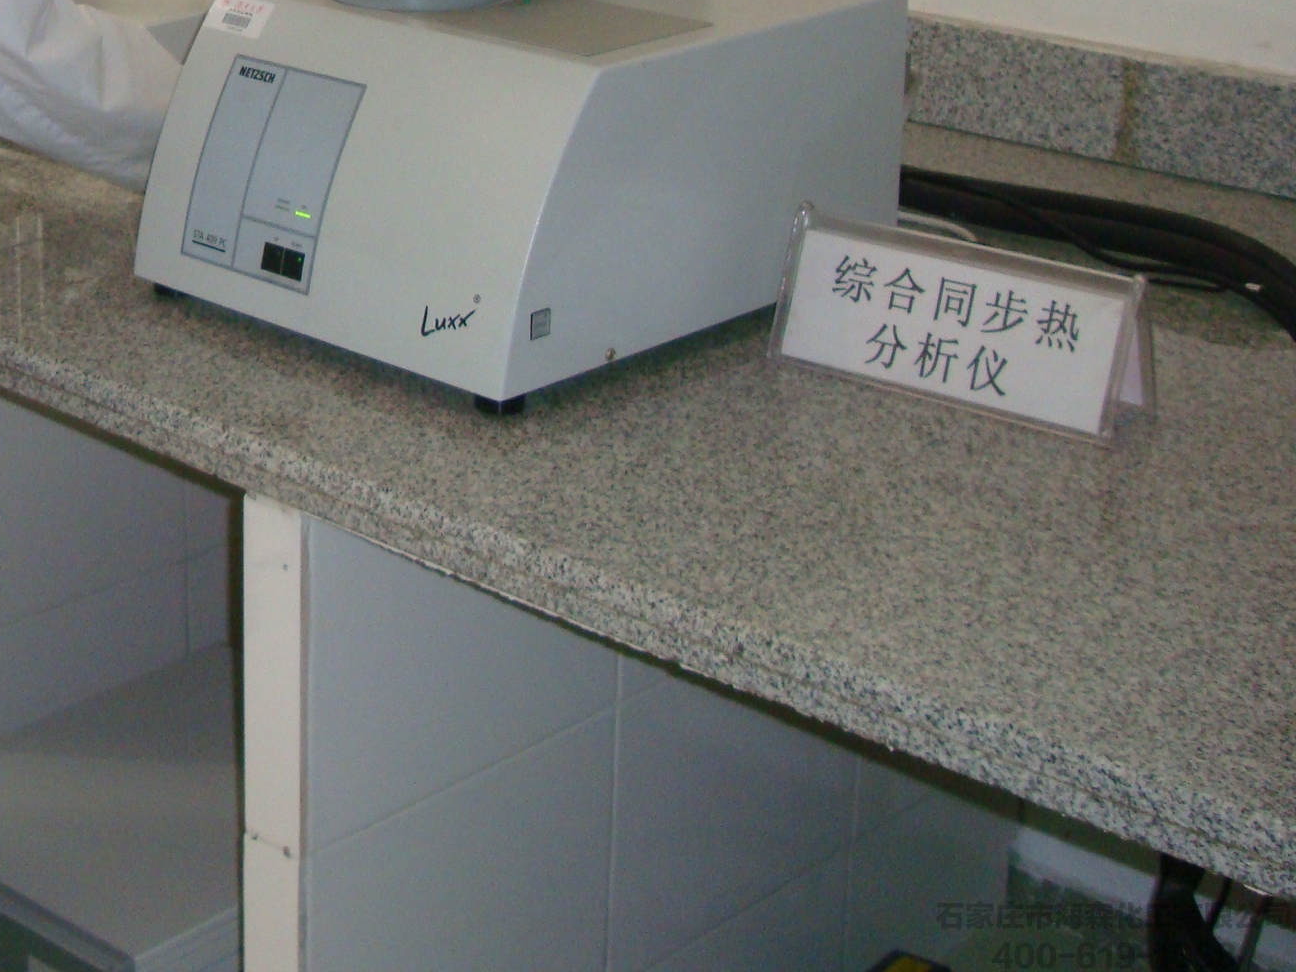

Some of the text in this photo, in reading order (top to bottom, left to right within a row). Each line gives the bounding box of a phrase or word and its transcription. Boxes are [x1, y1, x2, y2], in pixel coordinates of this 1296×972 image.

[239, 66, 276, 84] NETZSCH
[831, 254, 1080, 353] 综合同步热
[864, 323, 1008, 397] 分析仪
